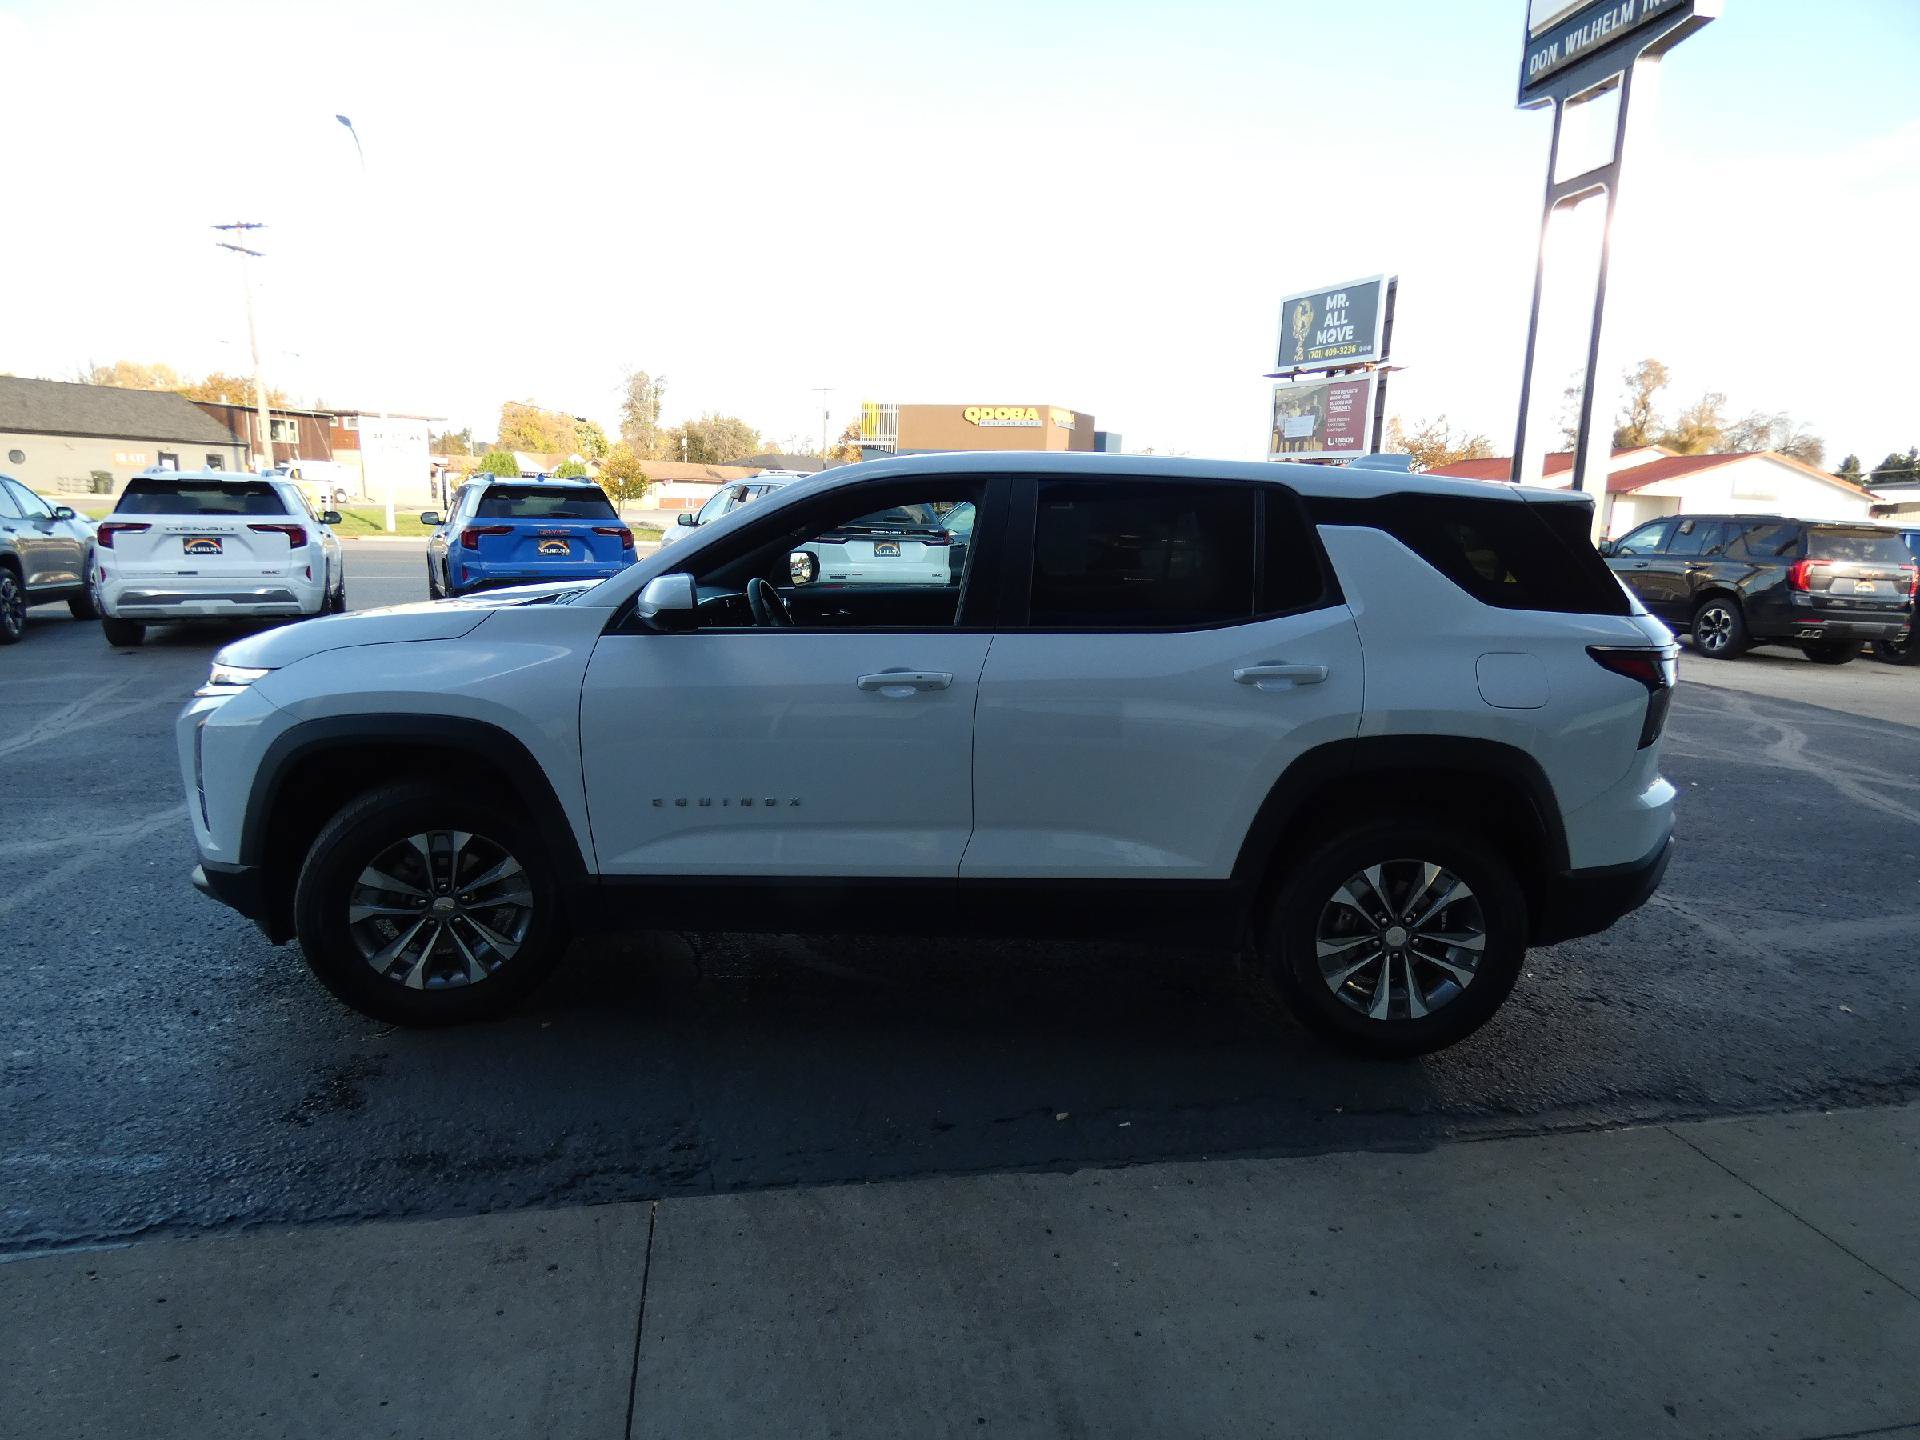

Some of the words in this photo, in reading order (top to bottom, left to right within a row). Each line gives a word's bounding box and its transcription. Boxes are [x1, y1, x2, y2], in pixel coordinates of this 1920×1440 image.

[1530, 43, 1558, 75] DON
[1565, 2, 1634, 57] WILHELM
[1326, 293, 1349, 310] MR.
[1324, 309, 1348, 327] ALL
[1316, 325, 1354, 345] MOVE
[964, 407, 1041, 425] QDOBA
[652, 798, 801, 807] EQUINOX
